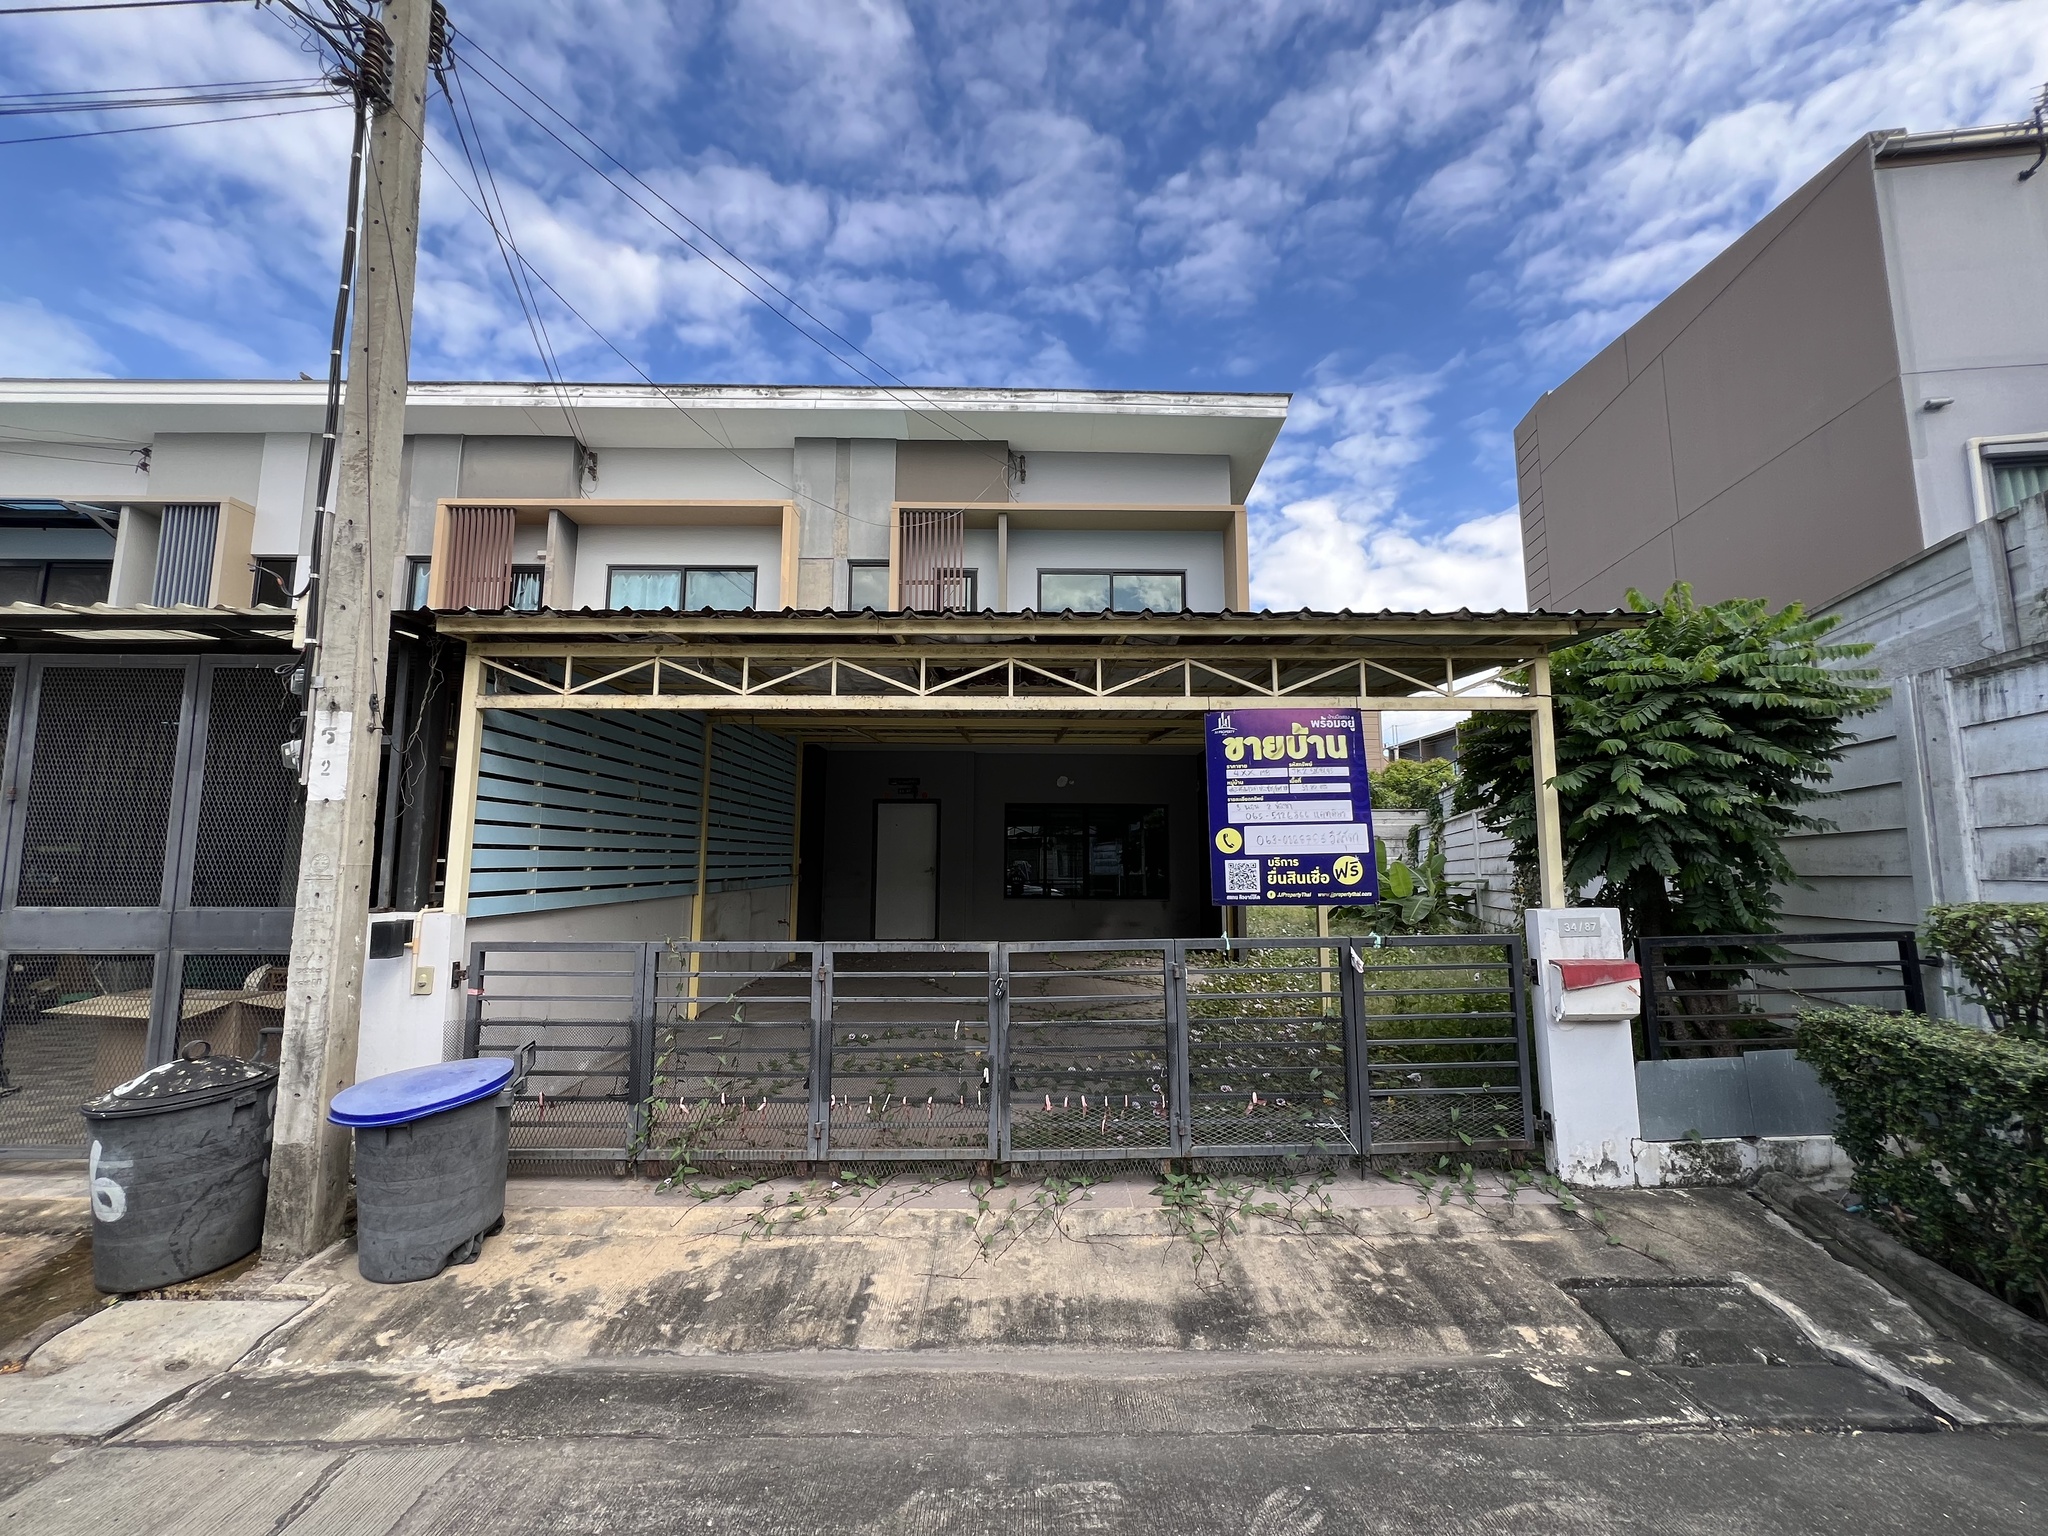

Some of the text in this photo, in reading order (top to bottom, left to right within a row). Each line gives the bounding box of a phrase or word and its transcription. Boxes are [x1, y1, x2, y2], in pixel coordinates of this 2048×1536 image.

[1310, 715, 1356, 732] พร้อมอยู่
[321, 726, 338, 745] 5
[1222, 722, 1349, 762] ขายบ้าน
[320, 759, 331, 776] 2
[1267, 856, 1299, 867] บริการ
[1335, 861, 1359, 880] ฟรี
[1267, 866, 1330, 885] ยื่นสินเชื่อ
[1564, 922, 1597, 933] 34/87
